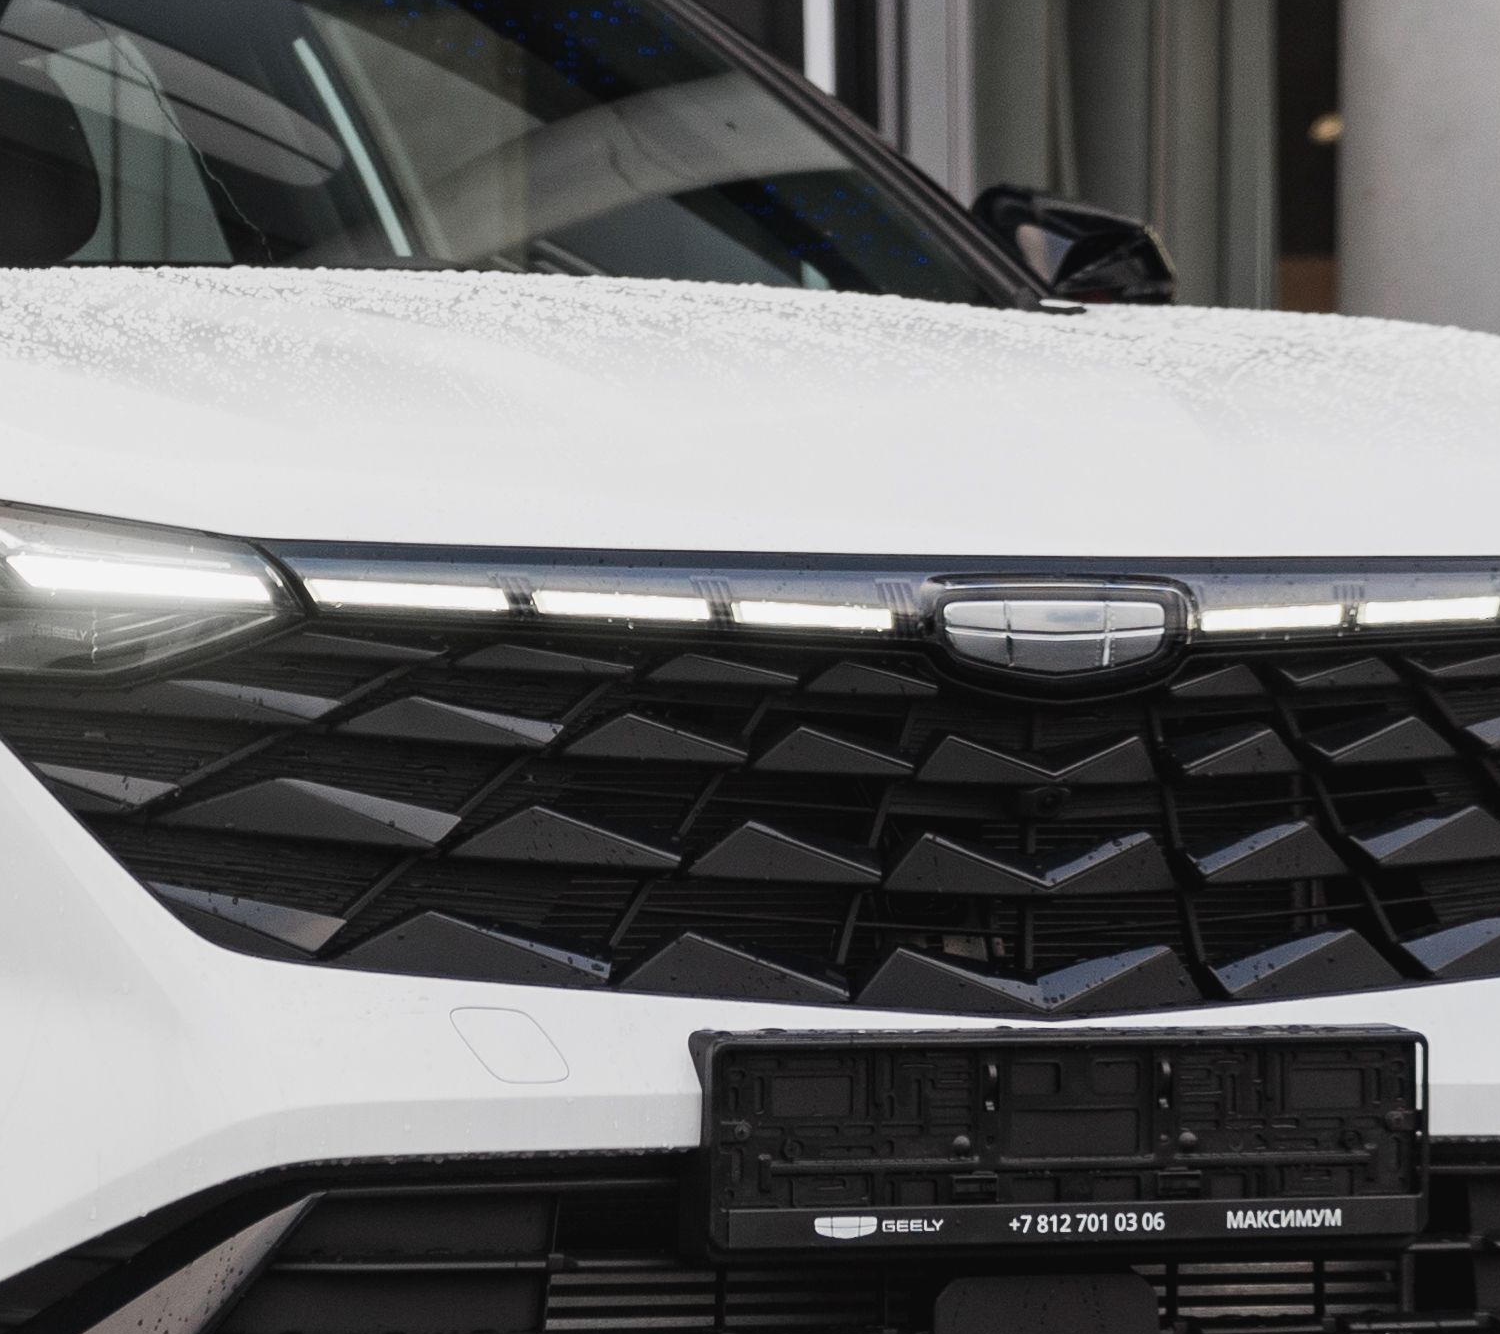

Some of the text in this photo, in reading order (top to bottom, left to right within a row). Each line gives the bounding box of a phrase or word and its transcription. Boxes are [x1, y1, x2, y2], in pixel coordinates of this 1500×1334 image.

[51, 625, 88, 642] GEELY
[881, 1208, 1342, 1234] GEELY +7 812 701 03 06 МАКСИМУМ
